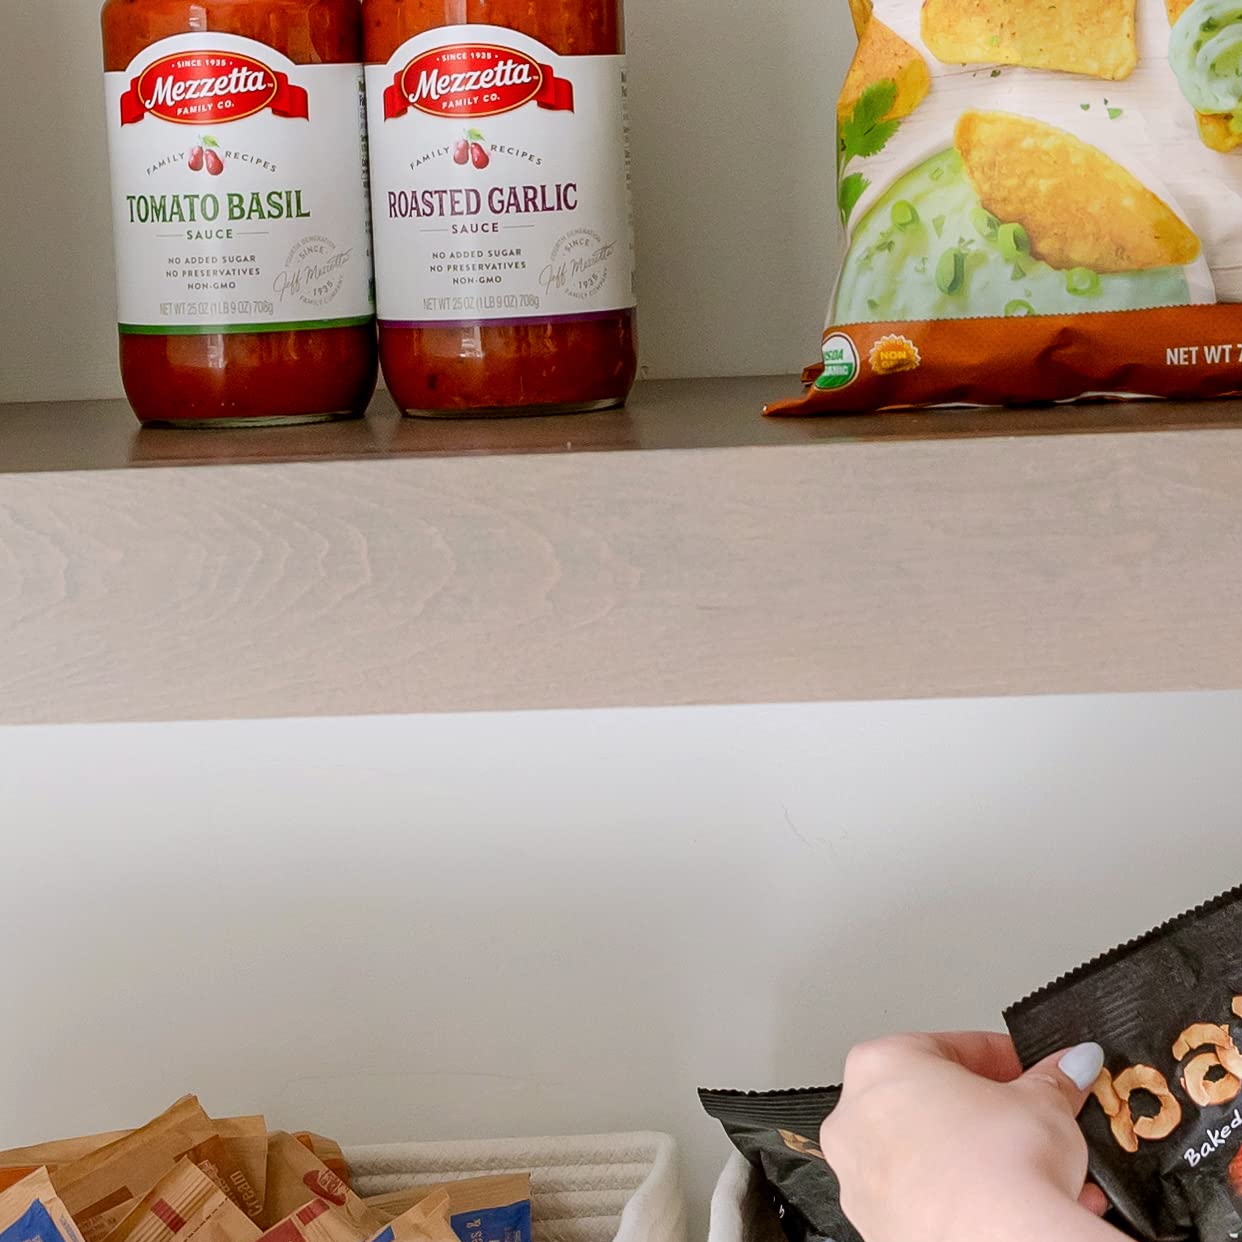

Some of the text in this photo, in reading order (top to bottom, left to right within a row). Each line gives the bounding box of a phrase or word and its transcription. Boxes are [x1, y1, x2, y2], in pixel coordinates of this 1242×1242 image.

[441, 52, 492, 62] SINCE 1935
[177, 59, 226, 68] SINCE 1935
[408, 59, 532, 103] Mezzetta
[145, 67, 267, 109] Mezzetta
[441, 93, 501, 109] FAMILY CO.
[177, 100, 235, 116] FAMILY CO.
[146, 150, 277, 175] FAMILY RECIPES
[409, 144, 543, 170] FAMILY RECIPES
[127, 190, 311, 223] TOMATO BASIL
[388, 183, 578, 218] ROASTED GARLIC
[451, 222, 499, 234] SAUCE
[186, 229, 233, 240] SAUCE
[184, 255, 218, 264] ADDED
[222, 254, 256, 263] SUGAR
[449, 250, 484, 259] ADDED
[487, 249, 522, 257] SUGAR
[166, 268, 261, 278] NO PRESERVATIVES
[447, 262, 526, 272] PRESERVATIVES
[187, 281, 236, 290] NON-GMO
[452, 276, 502, 285] NON-GMO
[880, 351, 907, 361] NON
[1166, 347, 1198, 365] NET
[1204, 344, 1232, 364] WT
[229, 1170, 264, 1217] Cream
